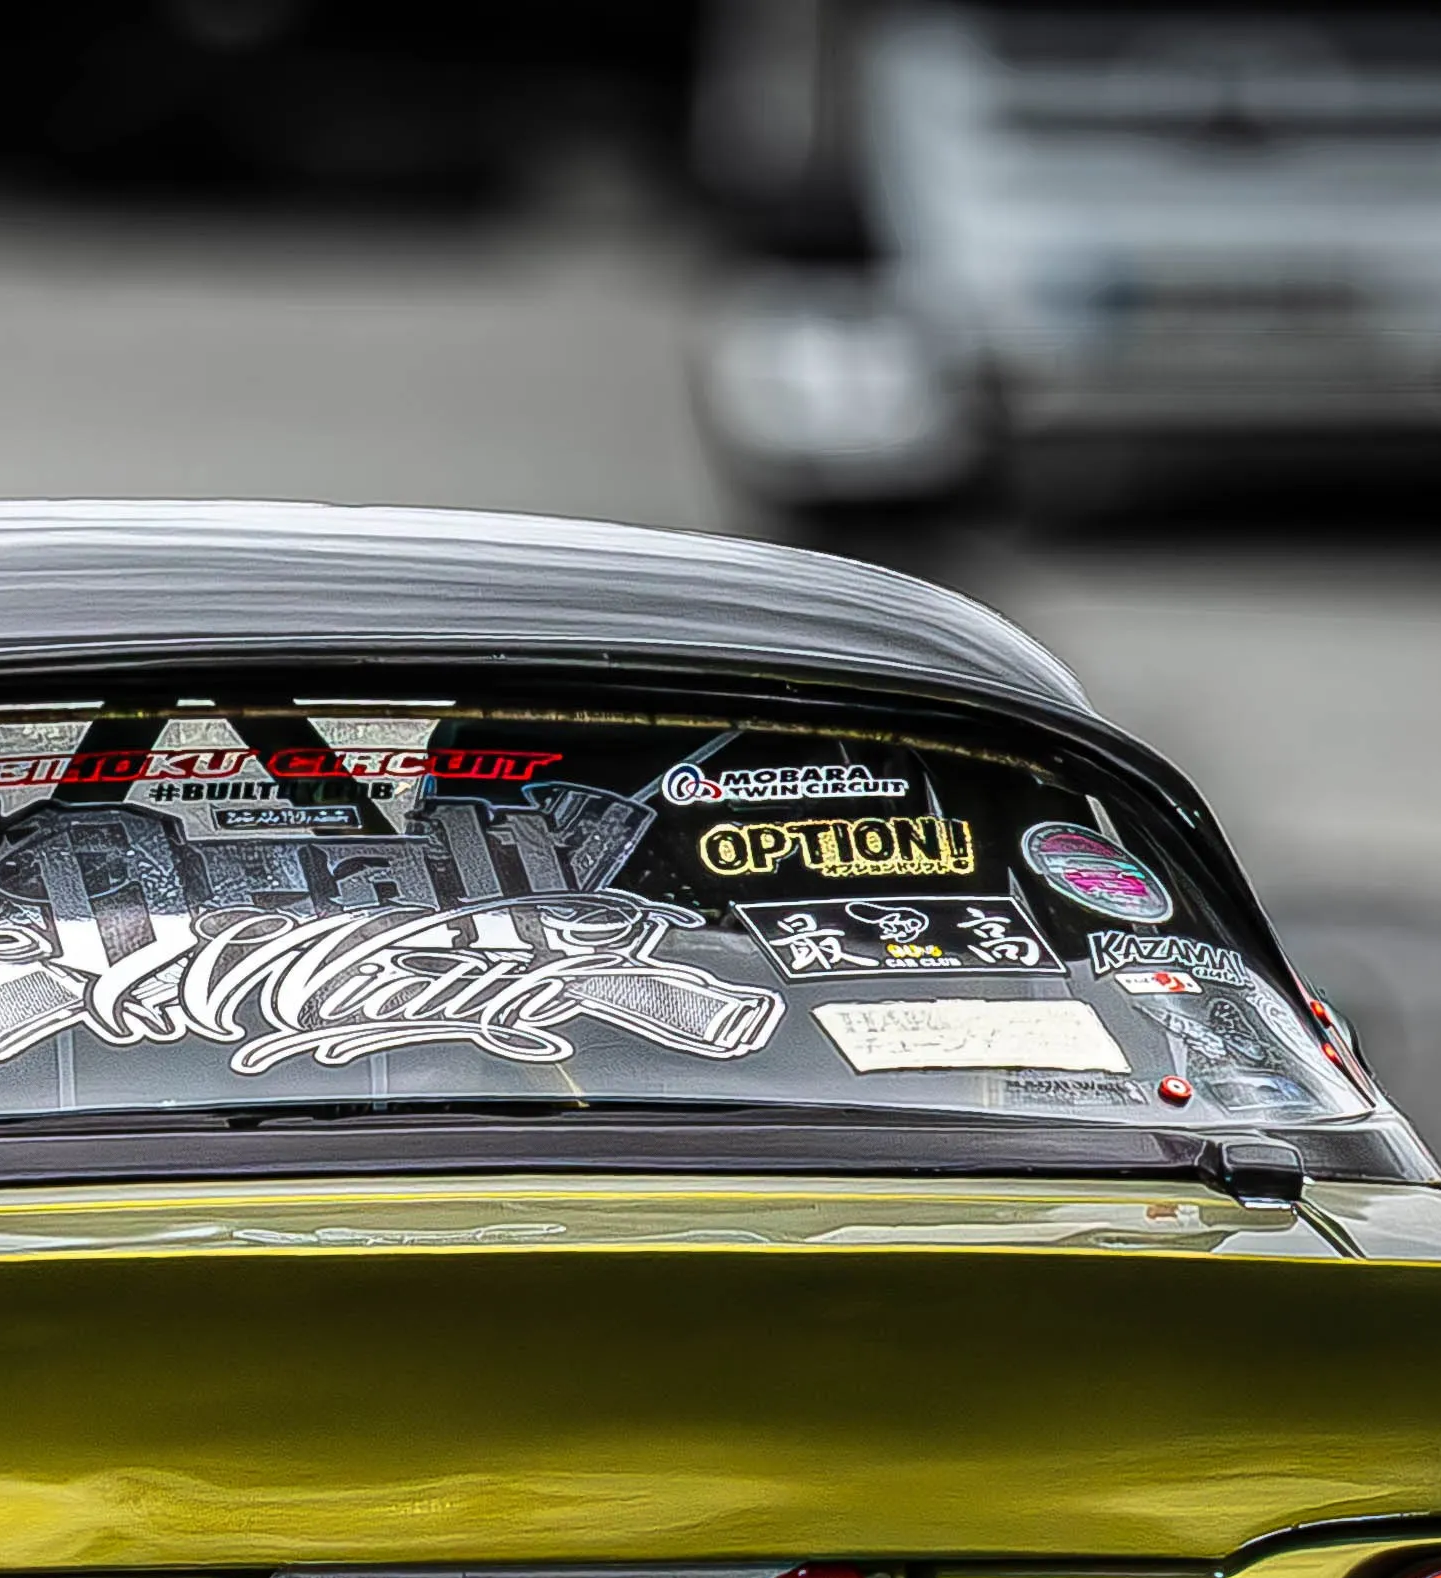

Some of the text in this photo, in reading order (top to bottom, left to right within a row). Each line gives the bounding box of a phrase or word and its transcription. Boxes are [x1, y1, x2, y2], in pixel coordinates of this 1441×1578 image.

[267, 748, 563, 784] CIRCUIT
[722, 766, 870, 785] MOBARA
[728, 780, 906, 797] TWIN CIRCUIT
[702, 817, 973, 874] OPTION!
[770, 907, 1041, 969] 最 高
[885, 958, 962, 968] CAR CLUB
